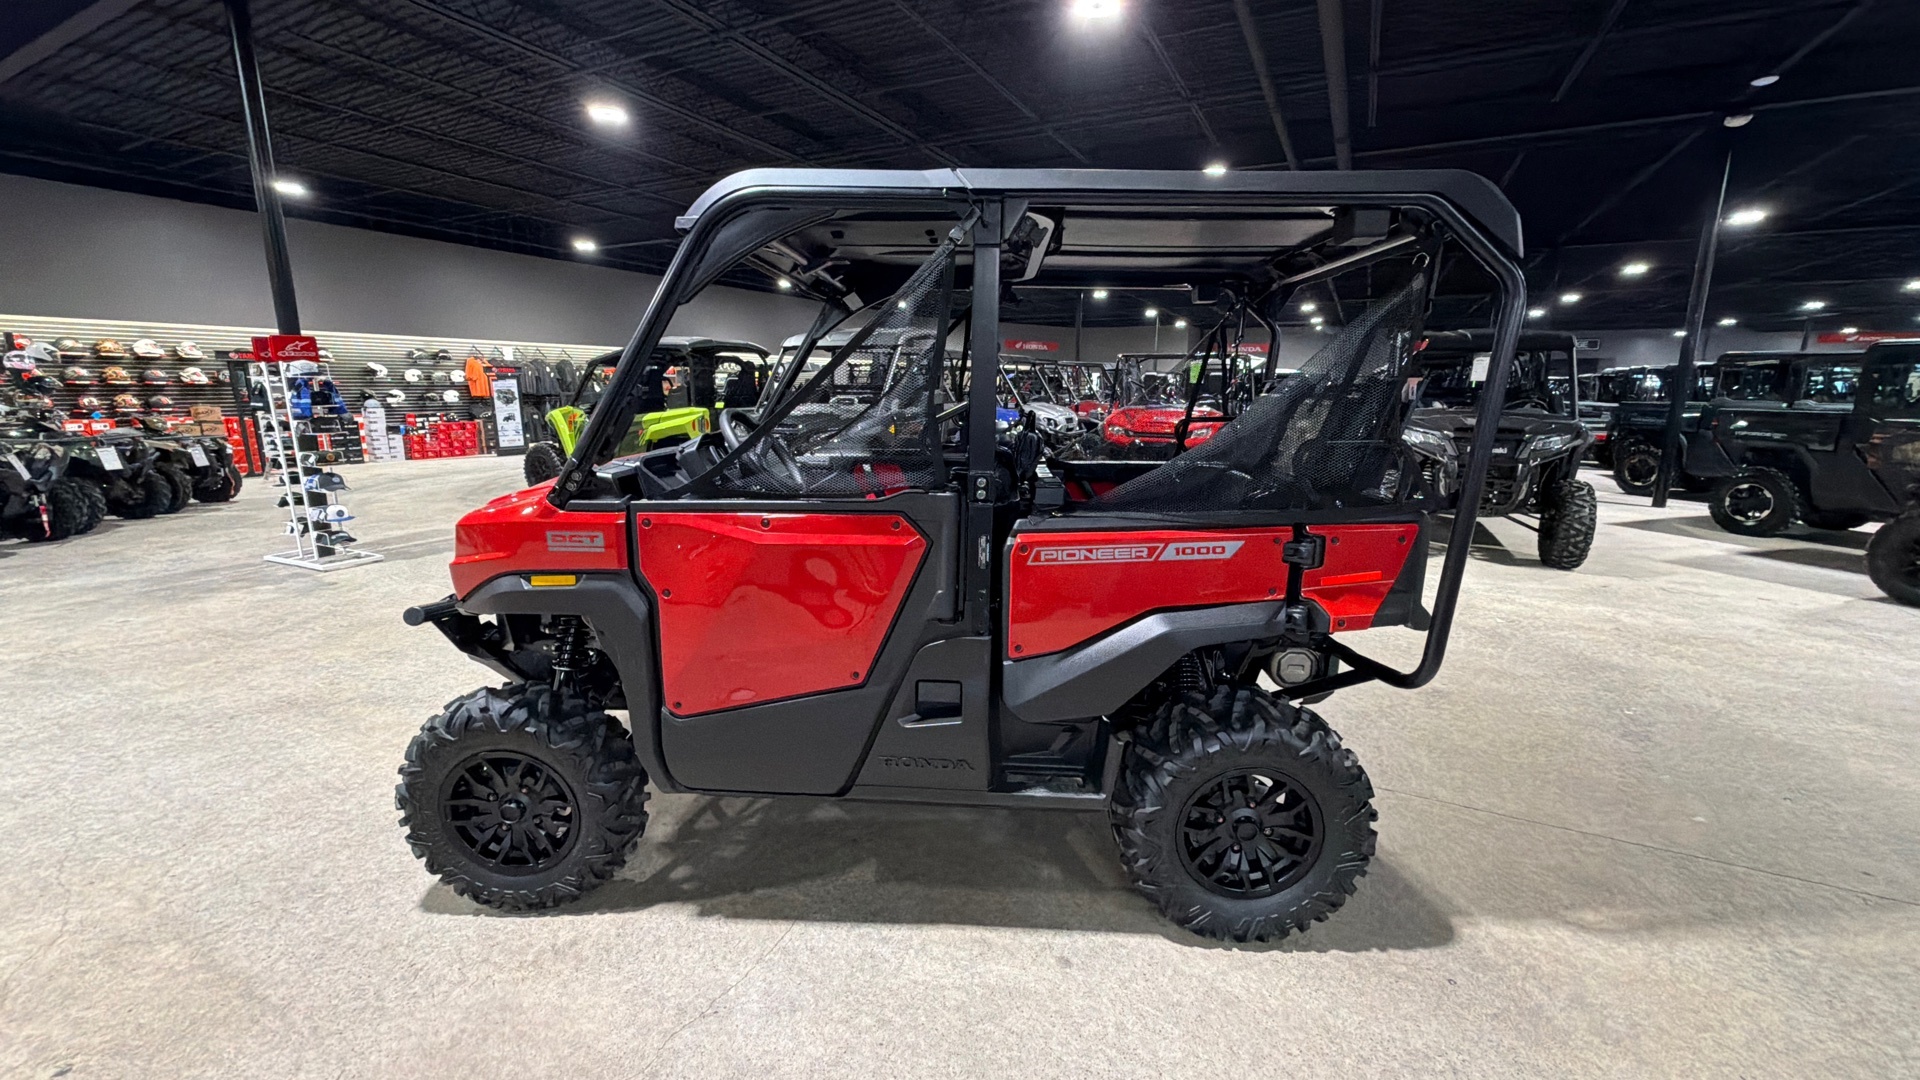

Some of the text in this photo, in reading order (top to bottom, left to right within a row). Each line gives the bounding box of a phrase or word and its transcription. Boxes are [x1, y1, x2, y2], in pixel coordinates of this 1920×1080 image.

[1023, 343, 1048, 351] HONDA
[551, 534, 600, 544] DCT
[1040, 545, 1226, 562] PIONEER 1000
[880, 755, 975, 770] HONDA
